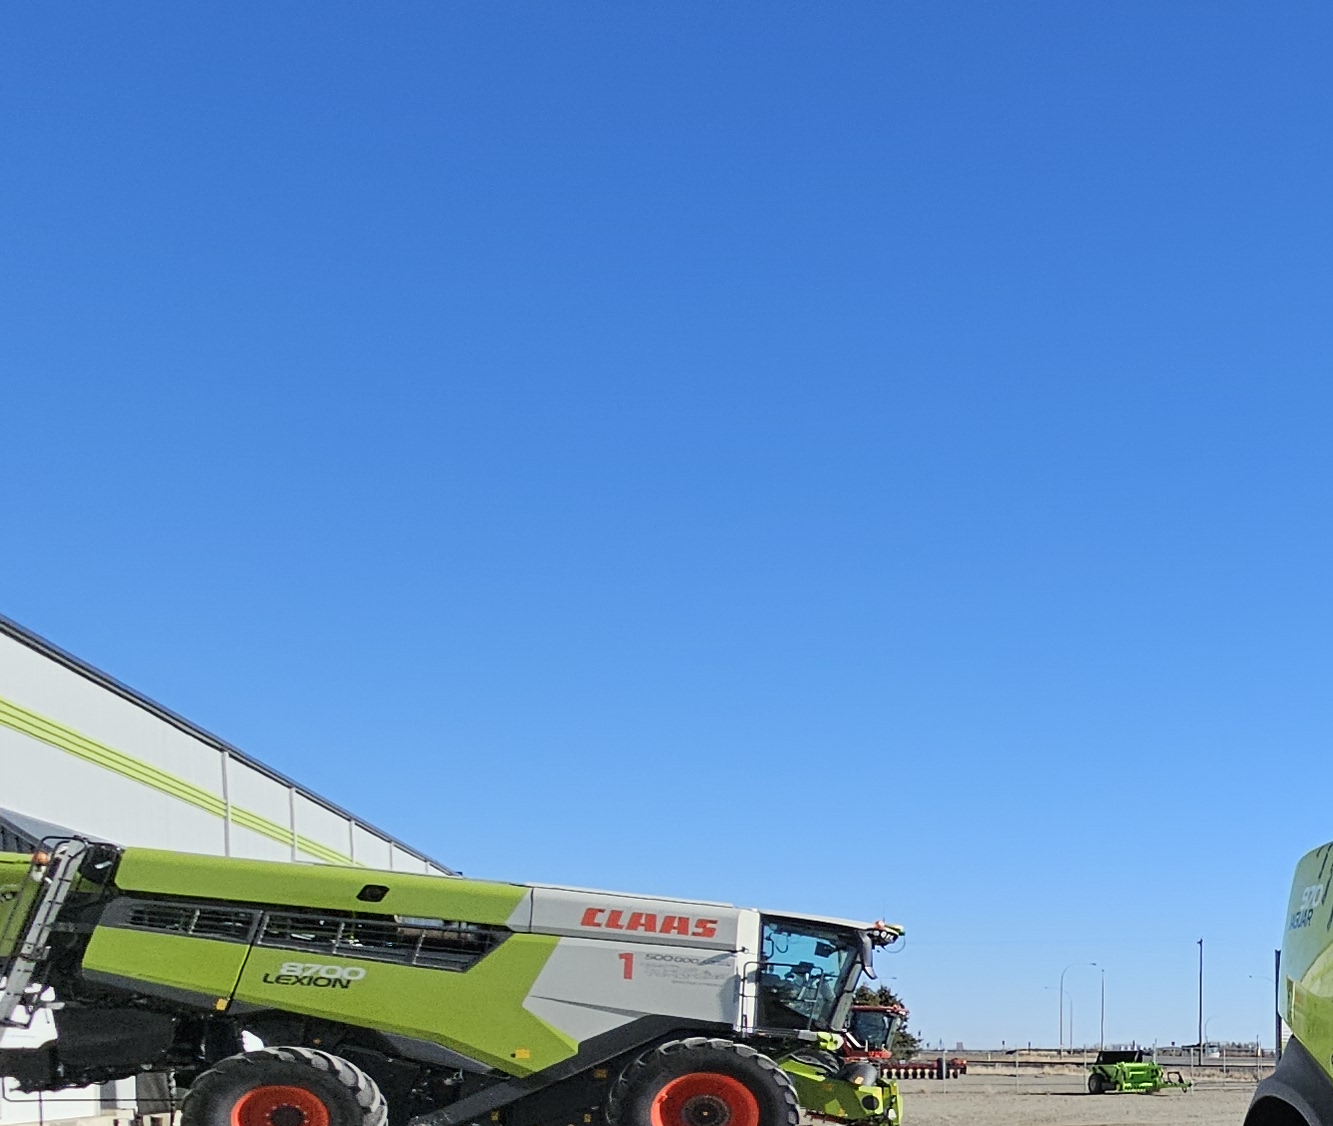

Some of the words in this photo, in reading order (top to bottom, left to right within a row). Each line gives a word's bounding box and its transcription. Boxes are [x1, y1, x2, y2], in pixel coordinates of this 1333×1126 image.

[580, 907, 718, 938] CLAAS
[280, 962, 367, 981] 8700
[618, 952, 634, 980] 1
[262, 972, 353, 989] LEXION
